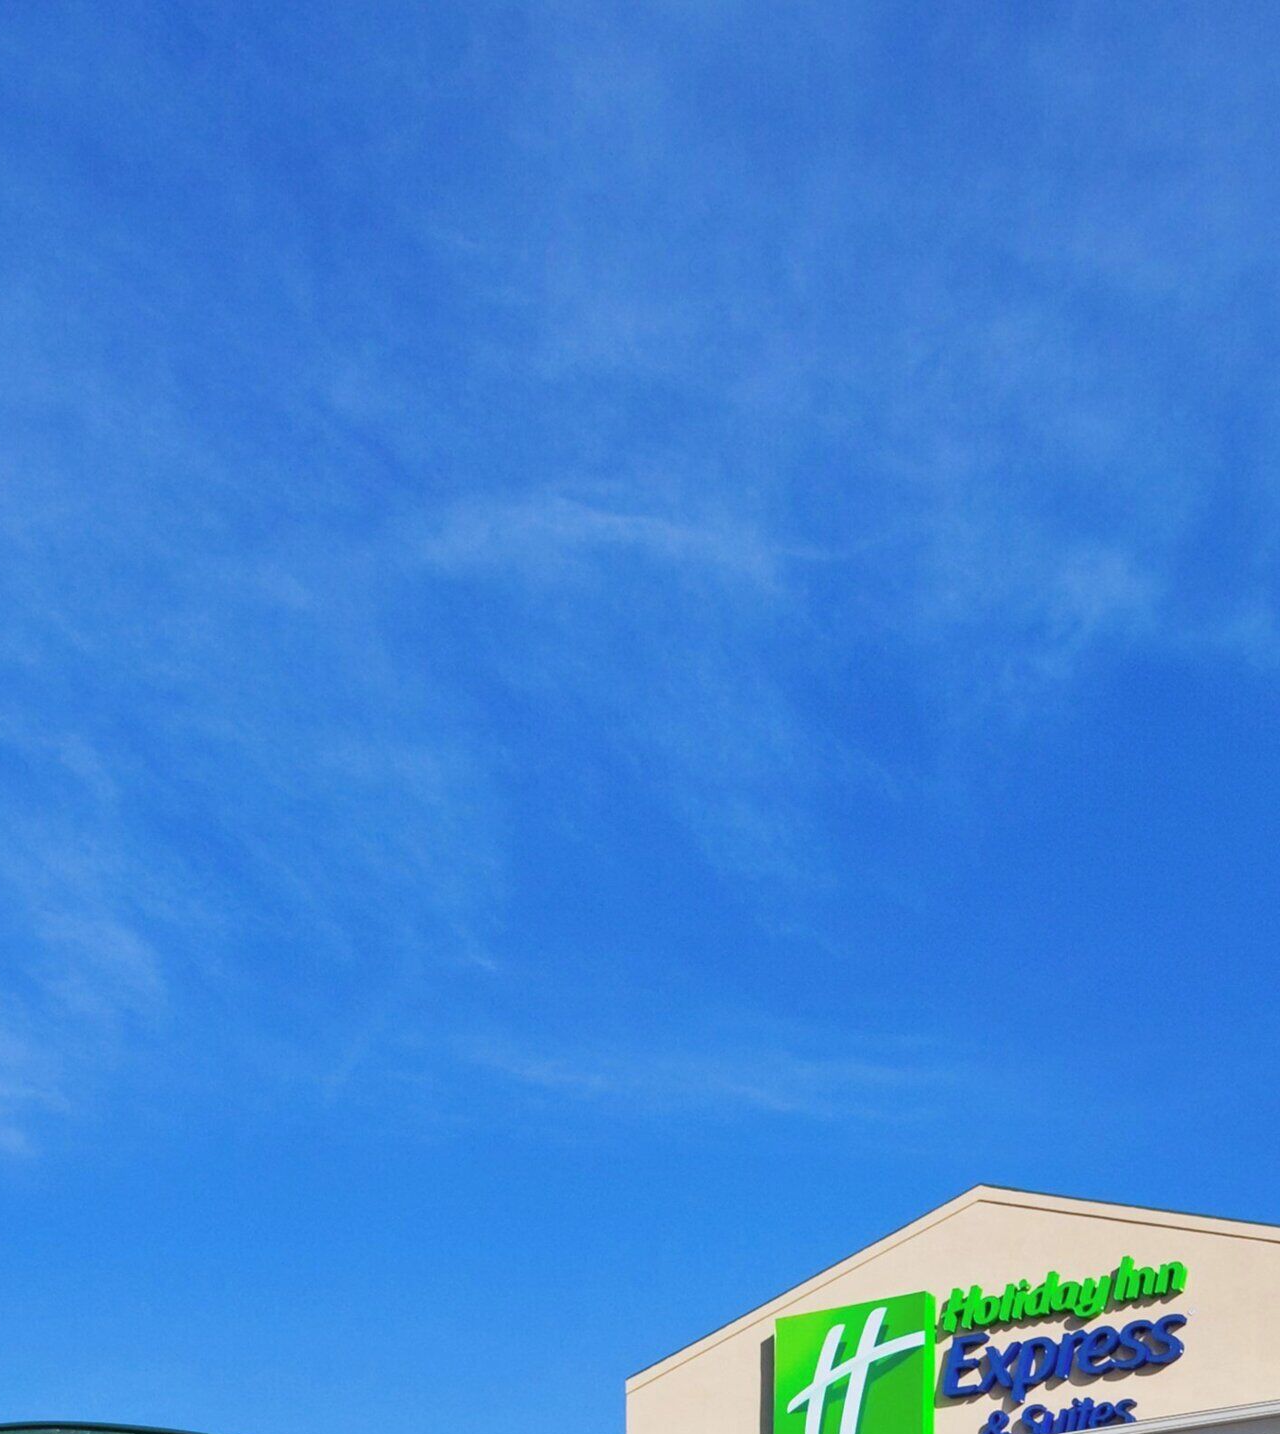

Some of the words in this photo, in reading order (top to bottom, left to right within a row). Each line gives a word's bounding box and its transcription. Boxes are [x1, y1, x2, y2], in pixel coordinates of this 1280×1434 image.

[941, 1271, 1111, 1332] Holiday
[1113, 1255, 1188, 1302] Inn
[942, 1314, 1188, 1404] Express
